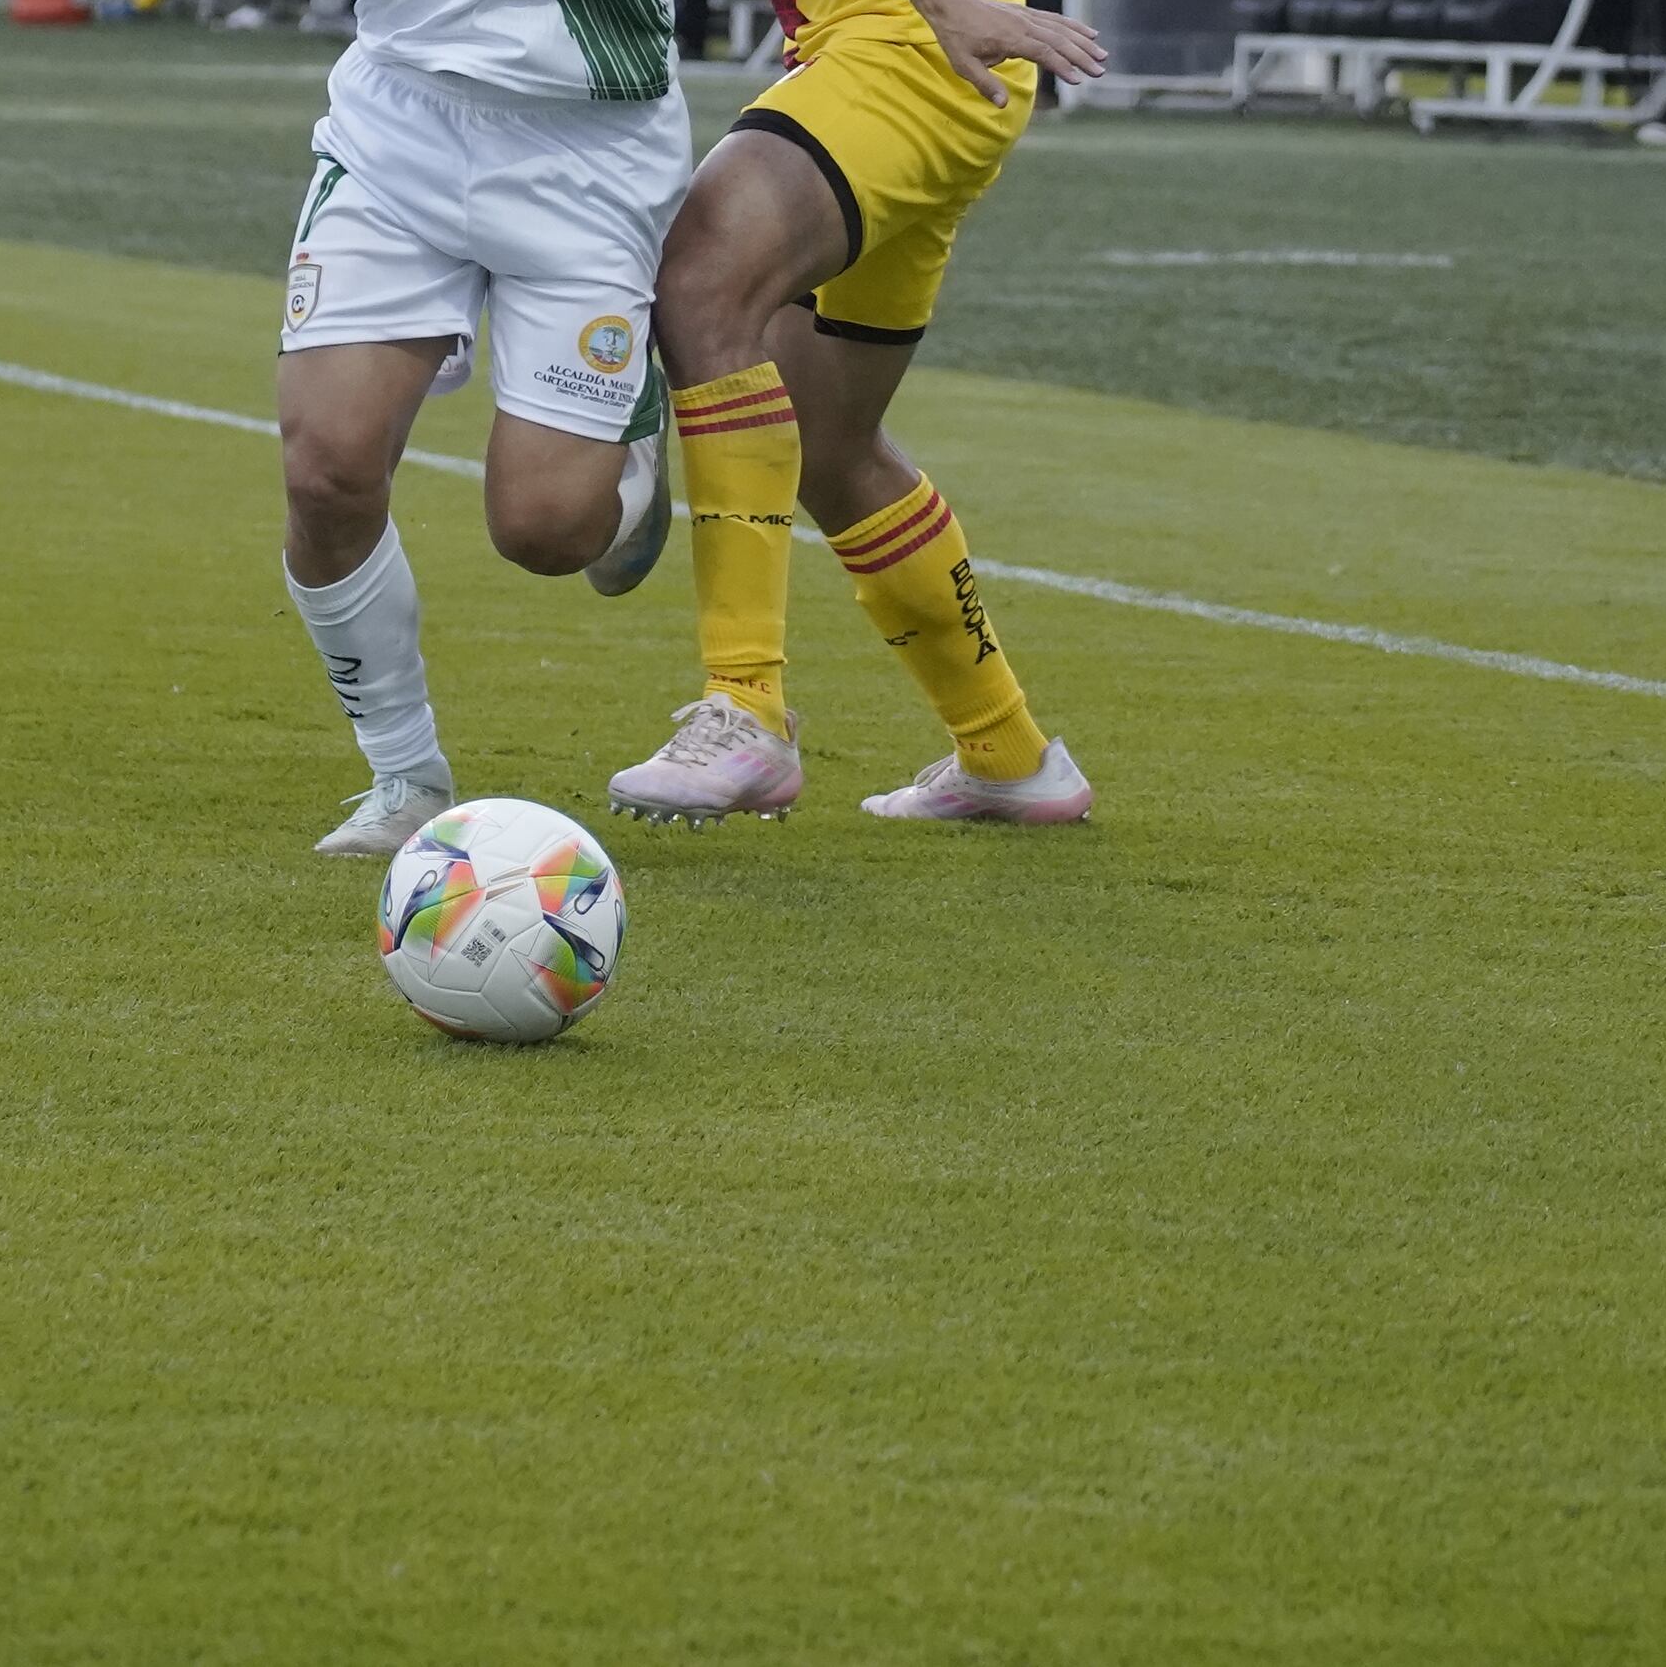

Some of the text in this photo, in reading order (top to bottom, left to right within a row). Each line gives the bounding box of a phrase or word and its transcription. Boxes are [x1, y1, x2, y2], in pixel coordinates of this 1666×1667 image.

[533, 371, 600, 397] CARTAGENA
[604, 391, 617, 399] DE
[548, 365, 605, 386] ALCALDÍA
